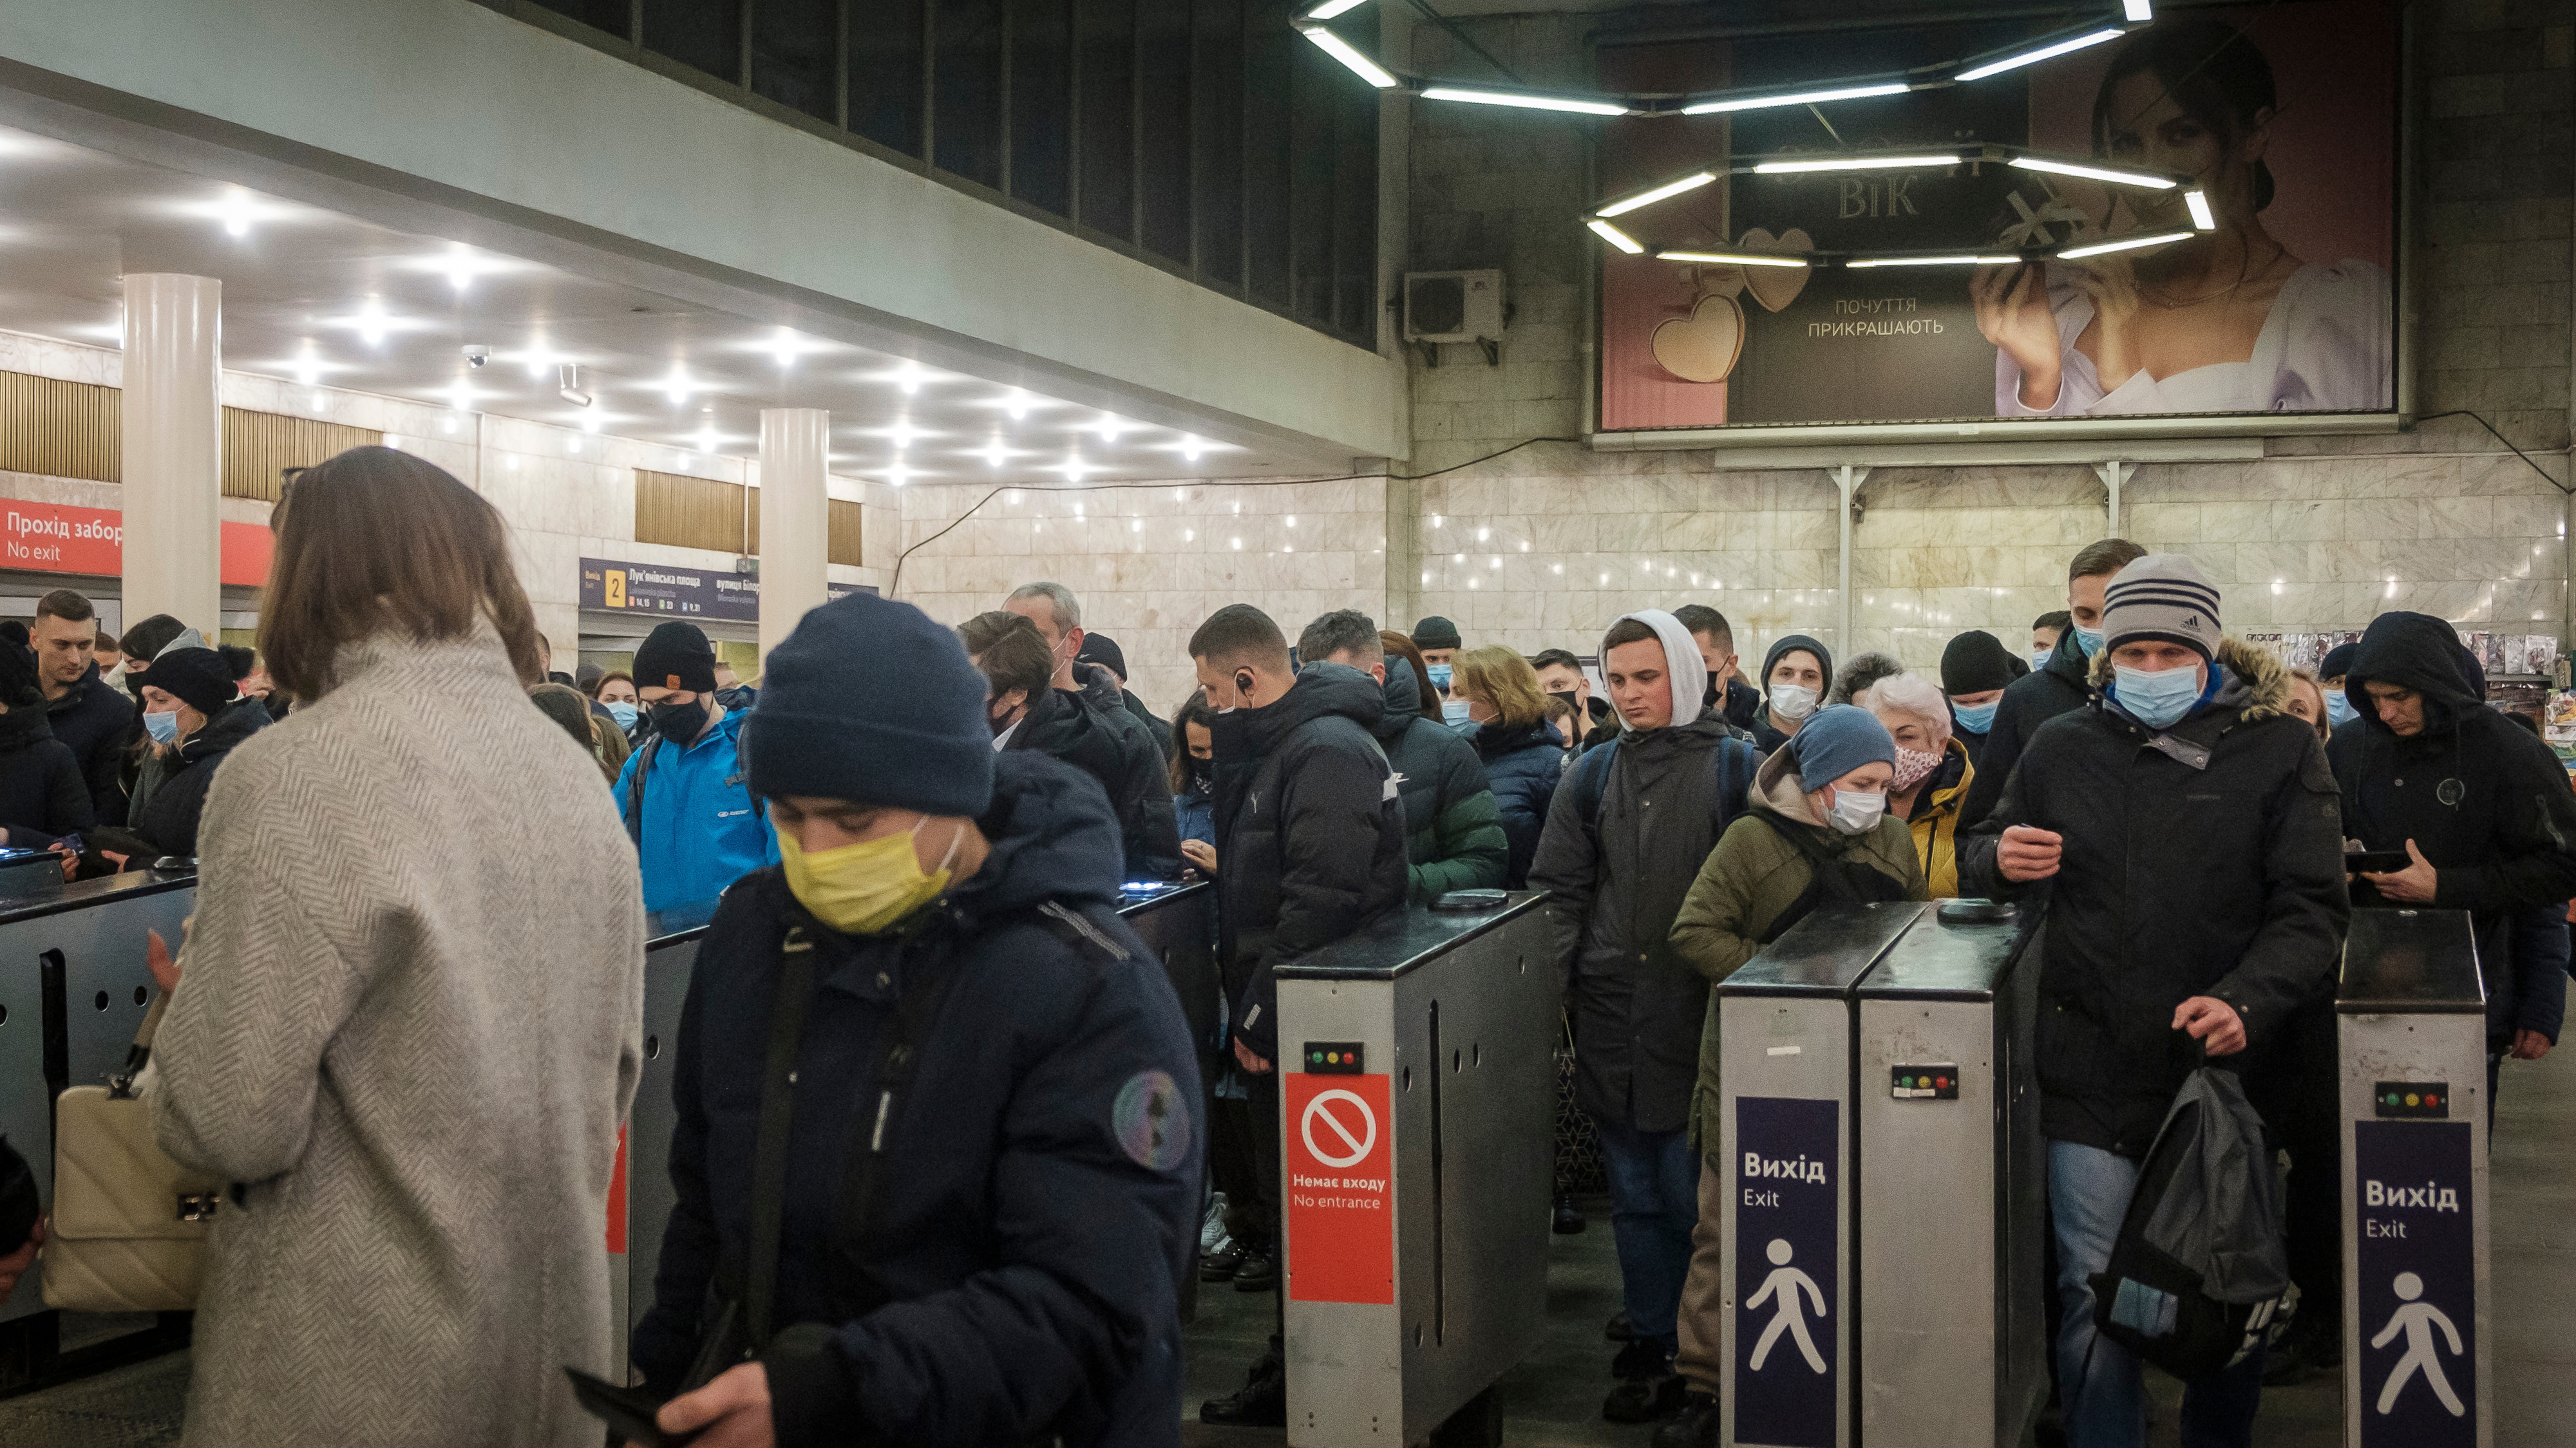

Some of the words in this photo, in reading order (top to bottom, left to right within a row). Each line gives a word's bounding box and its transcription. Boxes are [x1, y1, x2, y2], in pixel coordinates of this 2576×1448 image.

[1835, 297, 1917, 315] ПОЧУТТЯ
[1808, 319, 1944, 337] ПРИКРАШАЮТЬ
[7, 511, 70, 540] Прохід
[7, 540, 30, 559] No
[33, 544, 61, 561] exit
[612, 578, 620, 599] 2
[1745, 1151, 1826, 1185] Вихід
[1293, 1173, 1340, 1189] Немає
[1342, 1178, 1386, 1194] входу
[1294, 1193, 1314, 1207] No
[1318, 1196, 1381, 1209] entrance
[1744, 1188, 1779, 1207] Exit
[2366, 1179, 2459, 1213] Вихід
[2366, 1218, 2407, 1239] Exit
